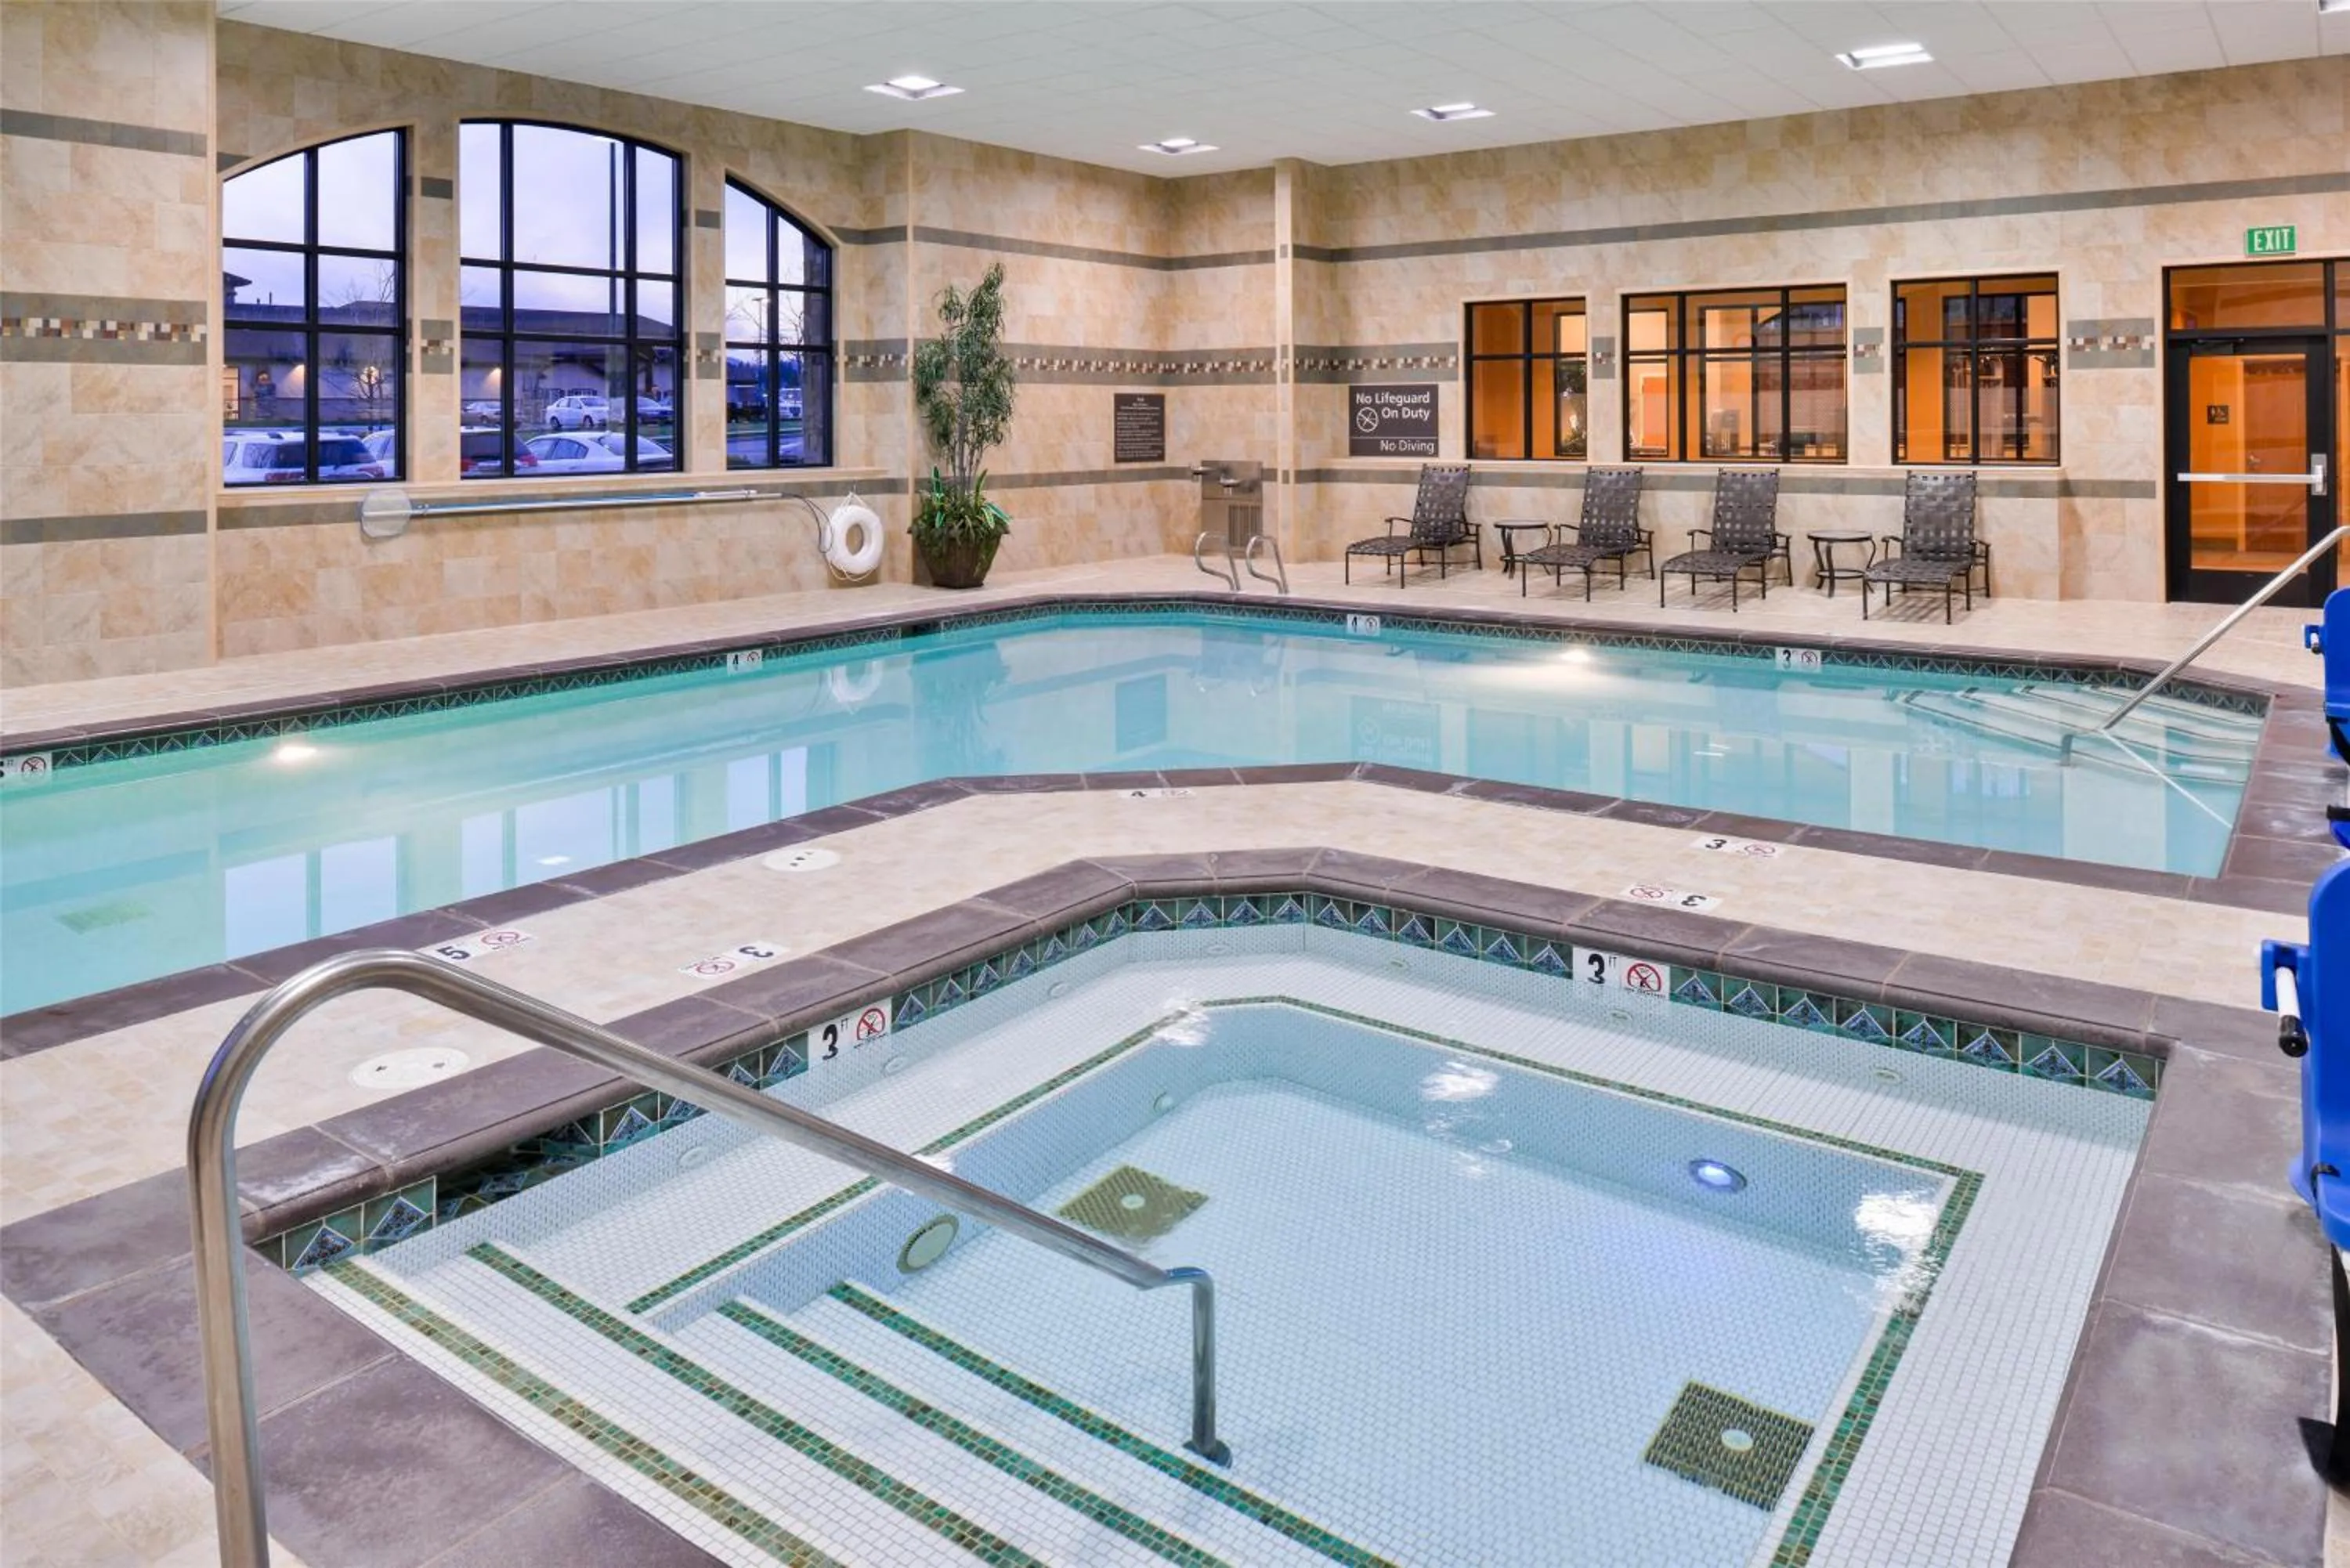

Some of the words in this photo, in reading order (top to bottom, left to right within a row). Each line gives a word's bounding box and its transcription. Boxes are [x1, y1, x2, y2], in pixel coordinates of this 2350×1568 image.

[2254, 228, 2290, 251] EXIT
[1356, 392, 1372, 404] No
[1375, 392, 1430, 406] Lifeguard
[1381, 407, 1398, 419] On
[1401, 407, 1430, 421] Duty
[1379, 439, 1397, 451] No
[1398, 439, 1434, 455] Diving
[1705, 839, 1727, 849] 3
[1681, 894, 1707, 906] 3
[437, 945, 471, 960] 5
[739, 946, 774, 958] 3
[1587, 953, 1606, 985] 3
[822, 1024, 839, 1060] 3
